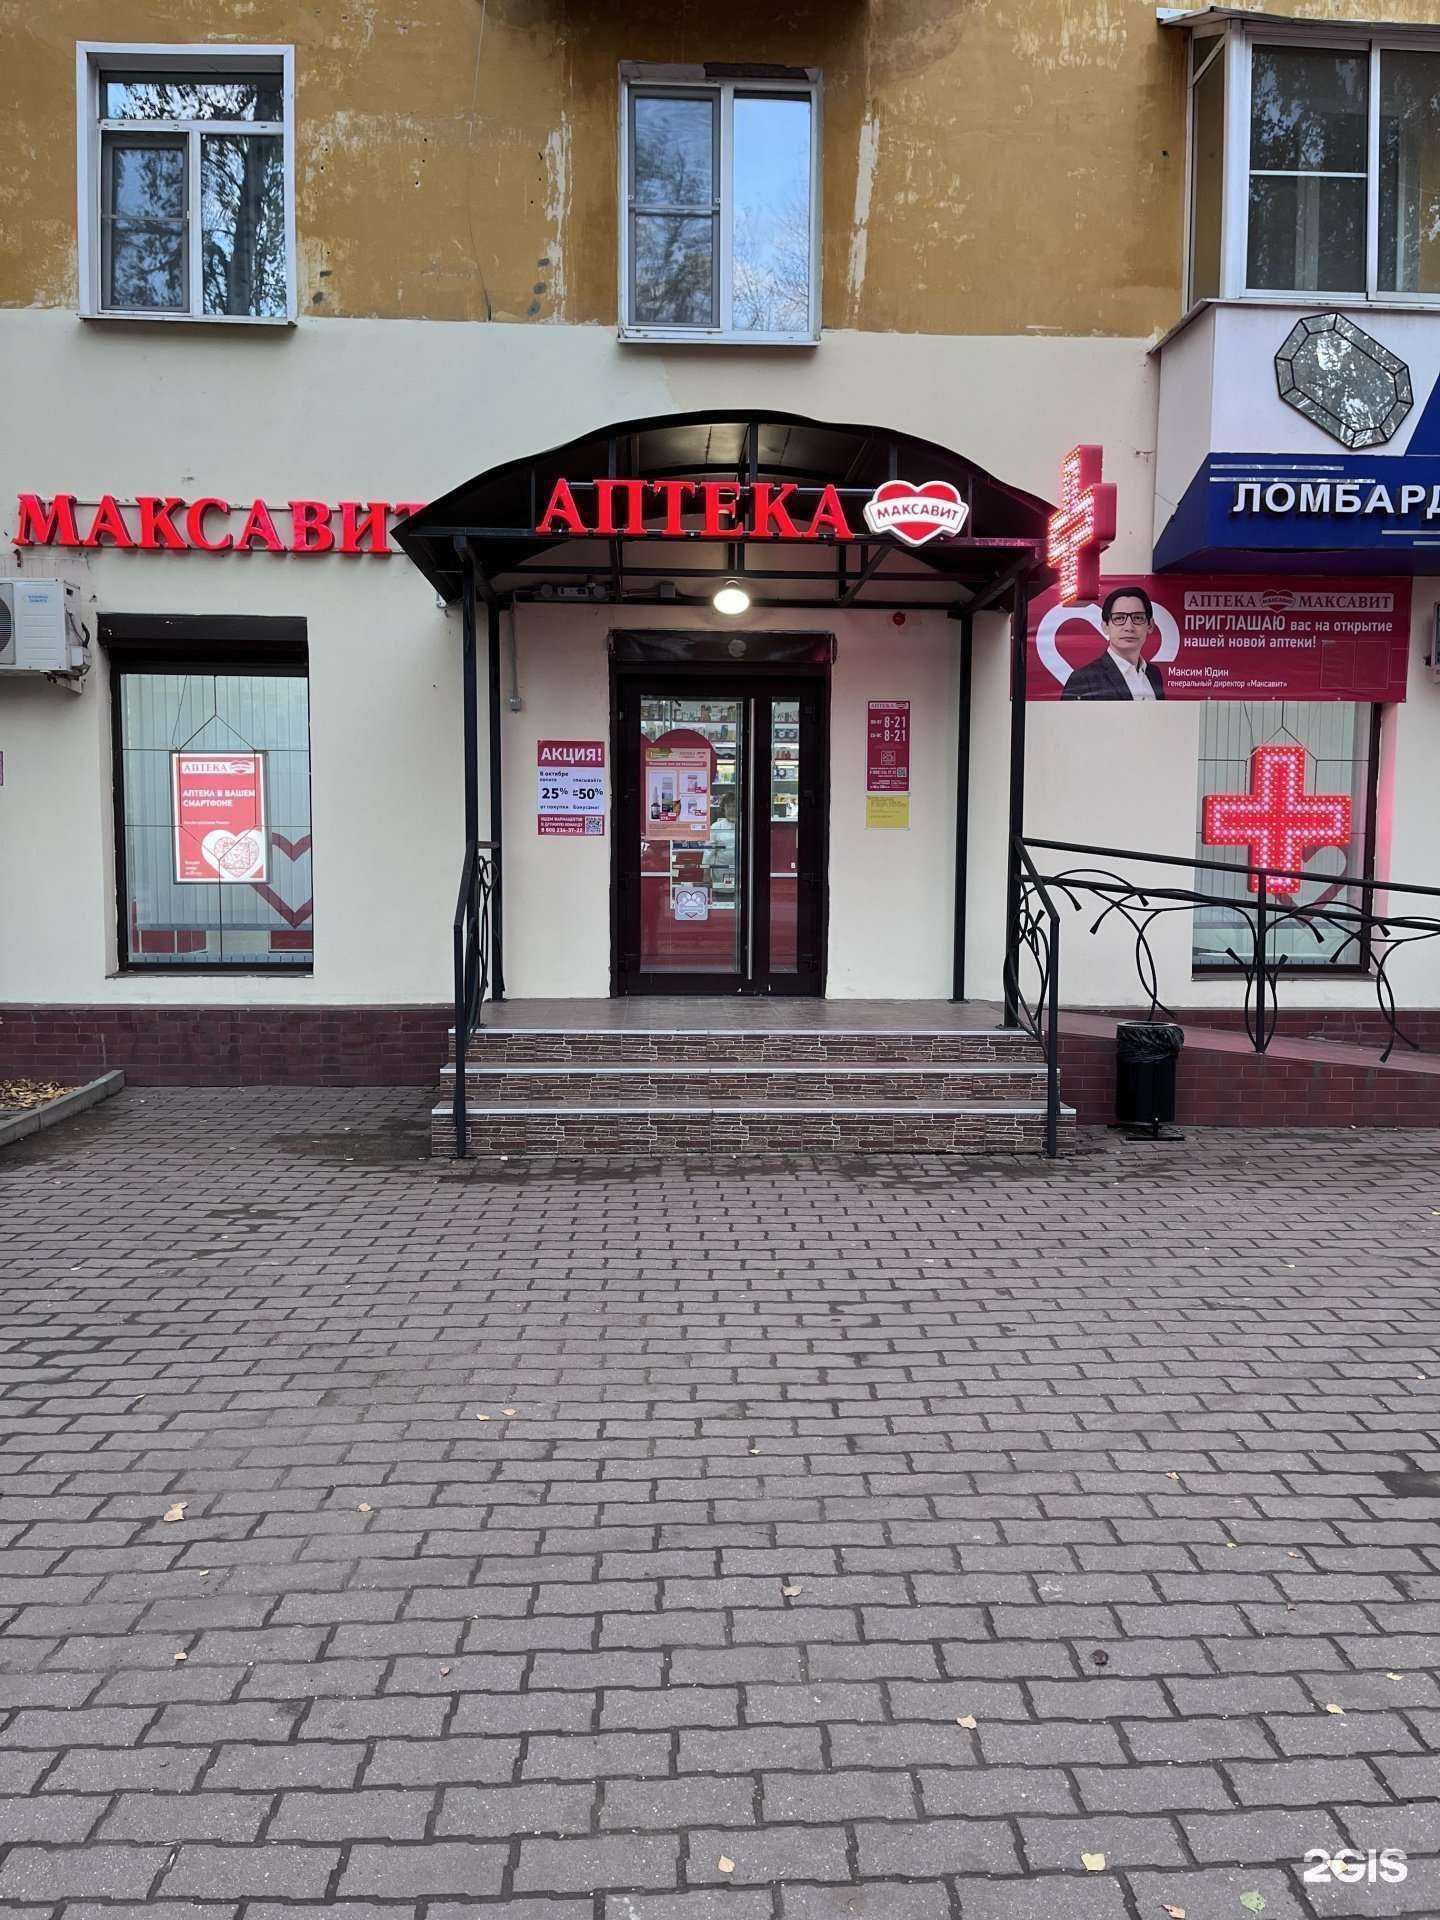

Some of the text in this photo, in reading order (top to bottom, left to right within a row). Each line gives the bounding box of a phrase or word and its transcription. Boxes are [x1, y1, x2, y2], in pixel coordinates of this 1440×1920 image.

[536, 478, 855, 539] АПТЕКА
[877, 503, 959, 520] МАКСАВИТ
[1187, 595, 1257, 608] АПТЕКА
[1299, 596, 1392, 609] МАКСАВИТ
[1184, 615, 1393, 634] ПРИГЛАШАЮ вас на открытие
[1184, 635, 1317, 649] нашей новой аптеки!
[1168, 666, 1229, 678] Максим Юдин
[1167, 680, 1287, 689] генеральный директор «Максавит»
[541, 747, 602, 764] АКЦИЯ!
[184, 763, 228, 772] АПТЕКА
[183, 789, 215, 797] АПТЕКА
[224, 789, 256, 797] ВАШЕМ
[541, 787, 569, 799] 25%
[183, 799, 233, 808] СМАРТФОНЕ
